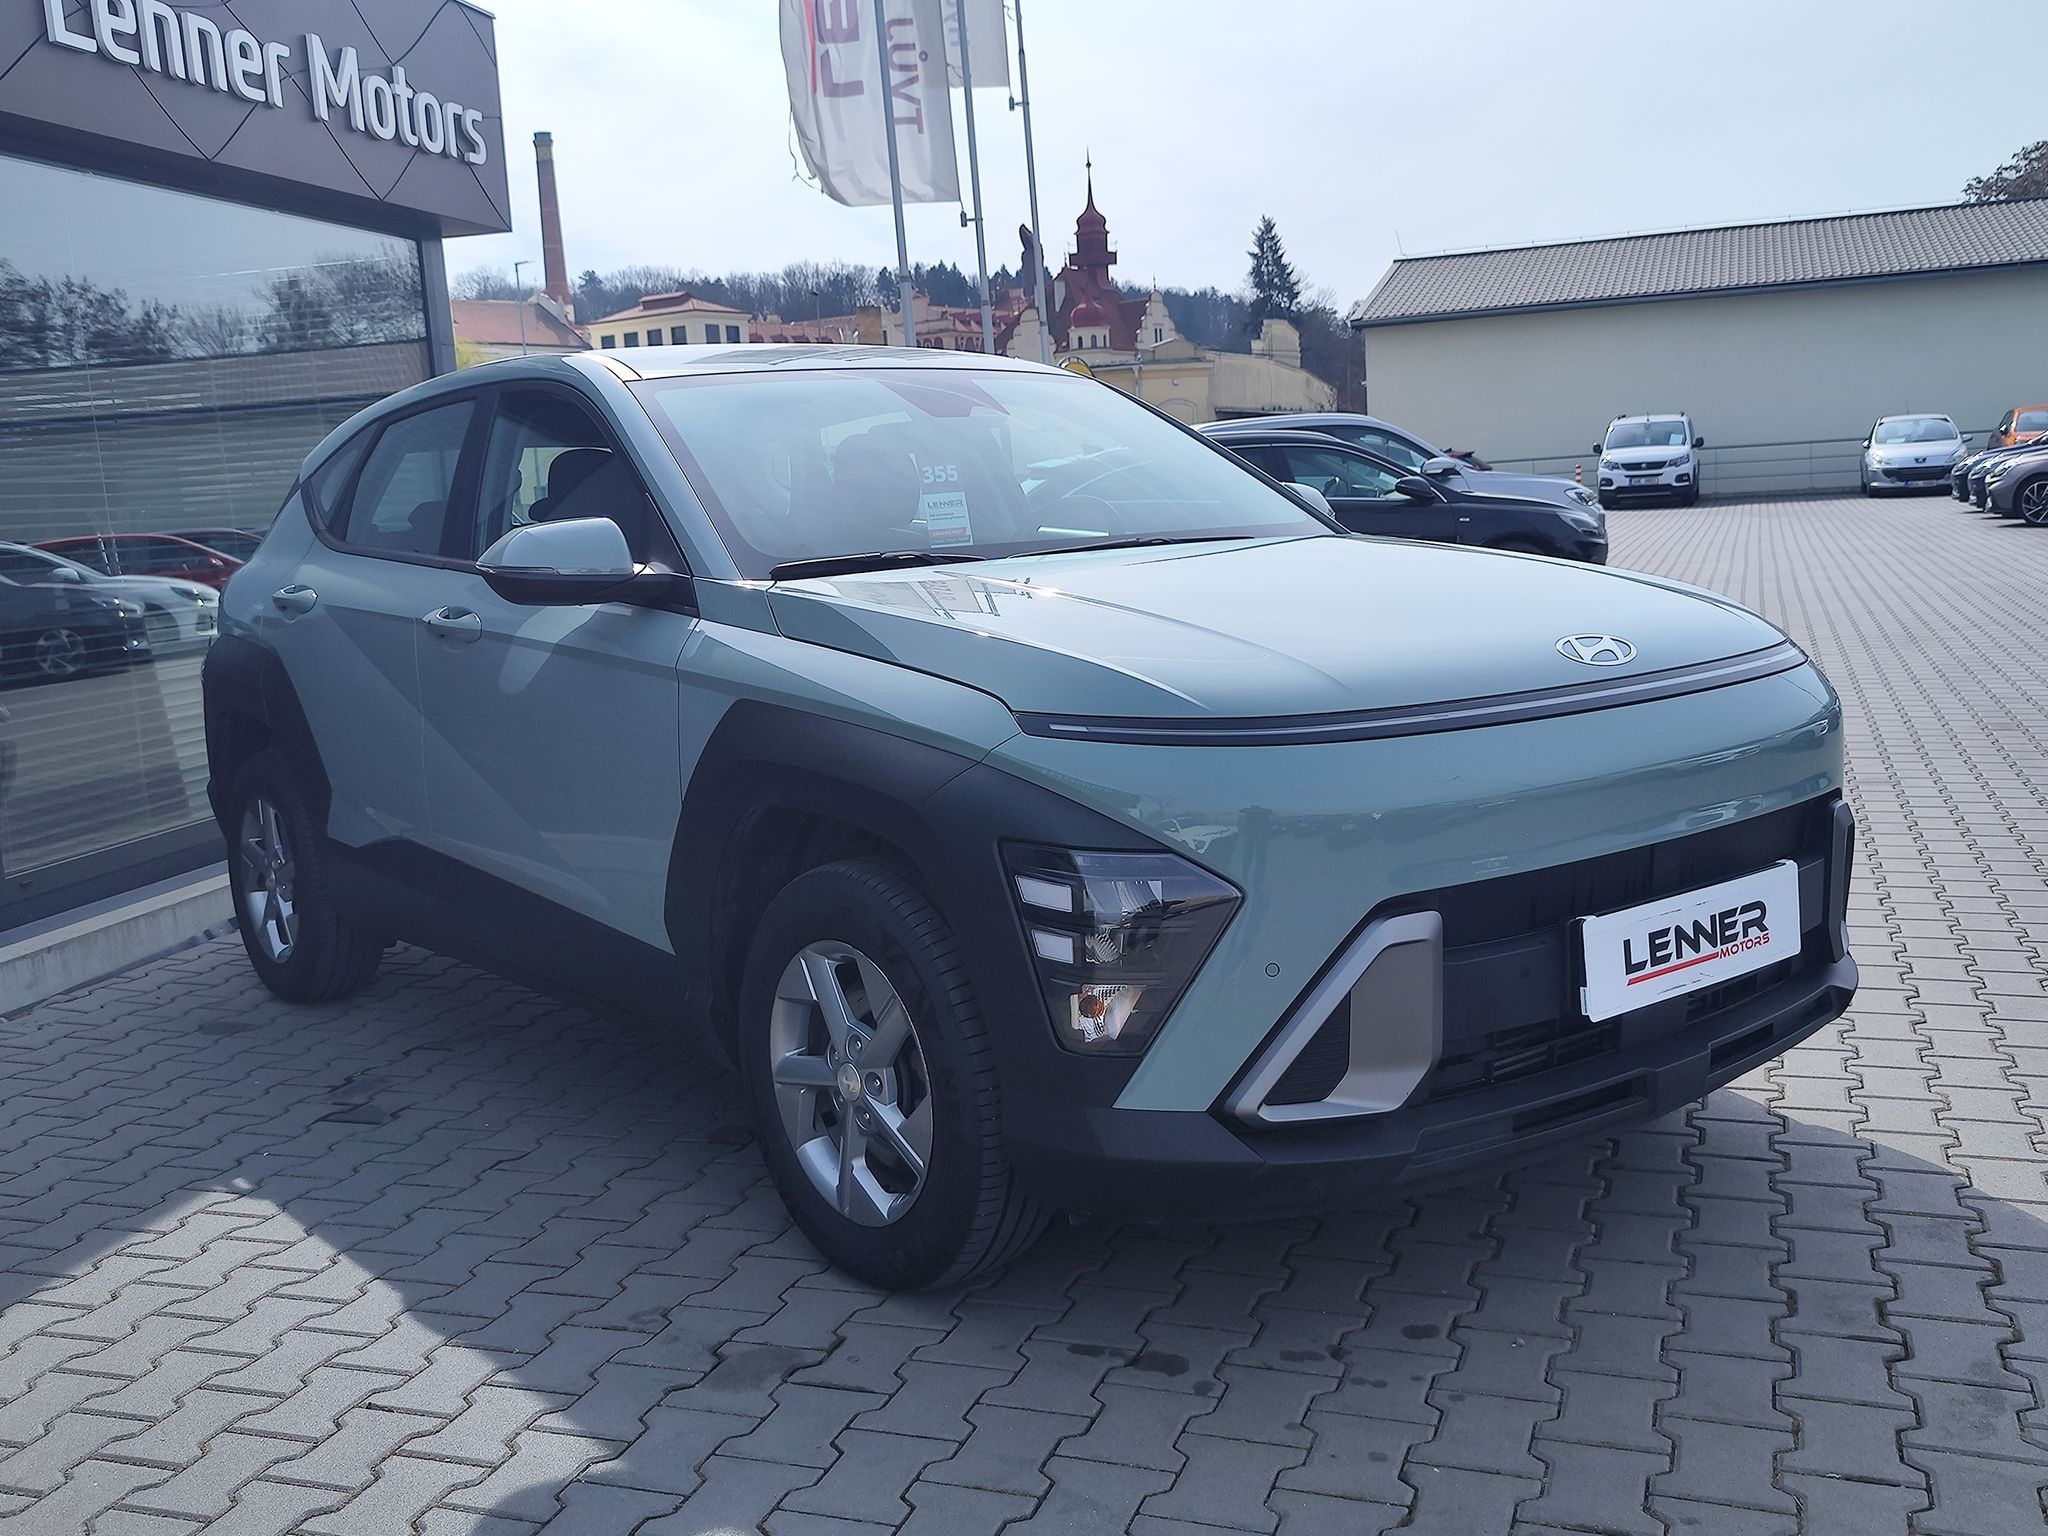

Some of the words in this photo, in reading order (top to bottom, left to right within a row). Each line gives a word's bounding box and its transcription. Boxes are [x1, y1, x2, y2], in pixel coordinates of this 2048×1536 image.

[44, 0, 291, 109] Lenner
[304, 32, 488, 166] Motors
[921, 464, 959, 484] 355
[1623, 900, 1769, 975] LENNER
[1719, 932, 1770, 959] MOTORS
